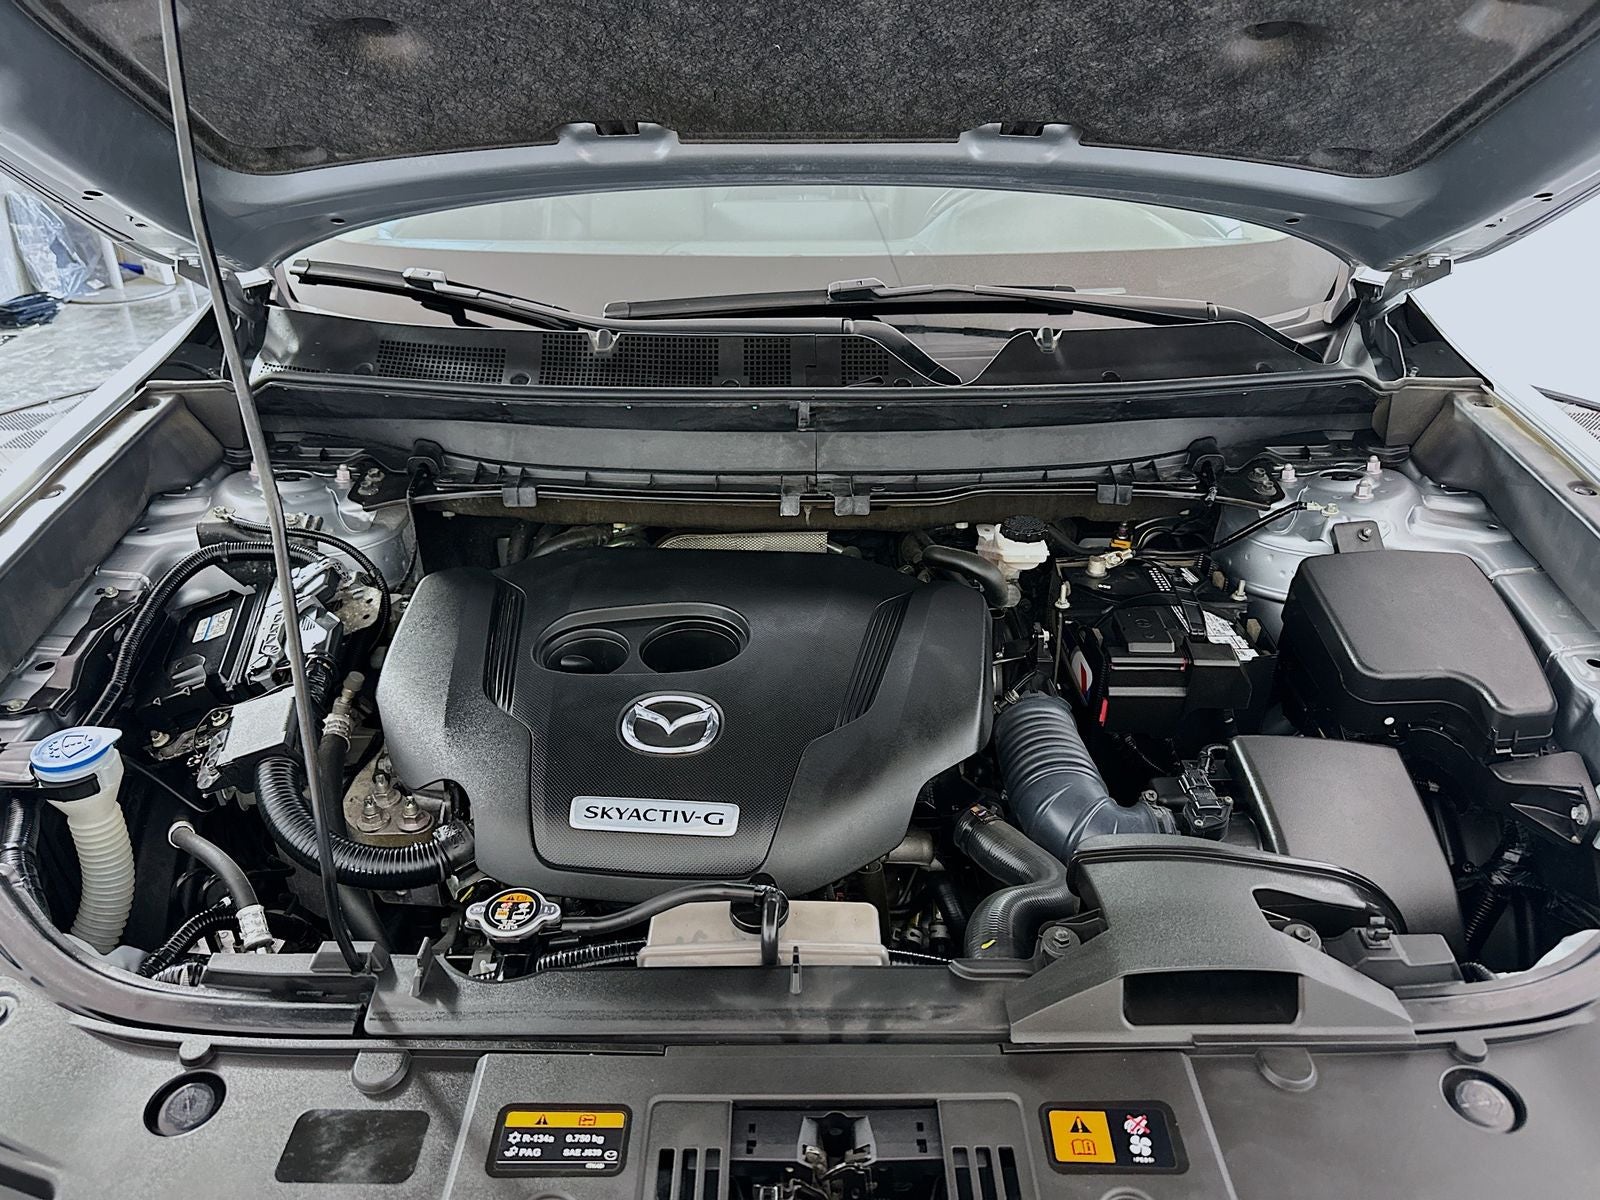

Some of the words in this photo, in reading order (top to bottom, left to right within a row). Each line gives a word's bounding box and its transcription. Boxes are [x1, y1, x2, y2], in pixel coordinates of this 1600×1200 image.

[584, 805, 725, 826] SKYACTIV-G
[518, 1148, 542, 1157] PAG
[562, 1148, 582, 1157] SAE
